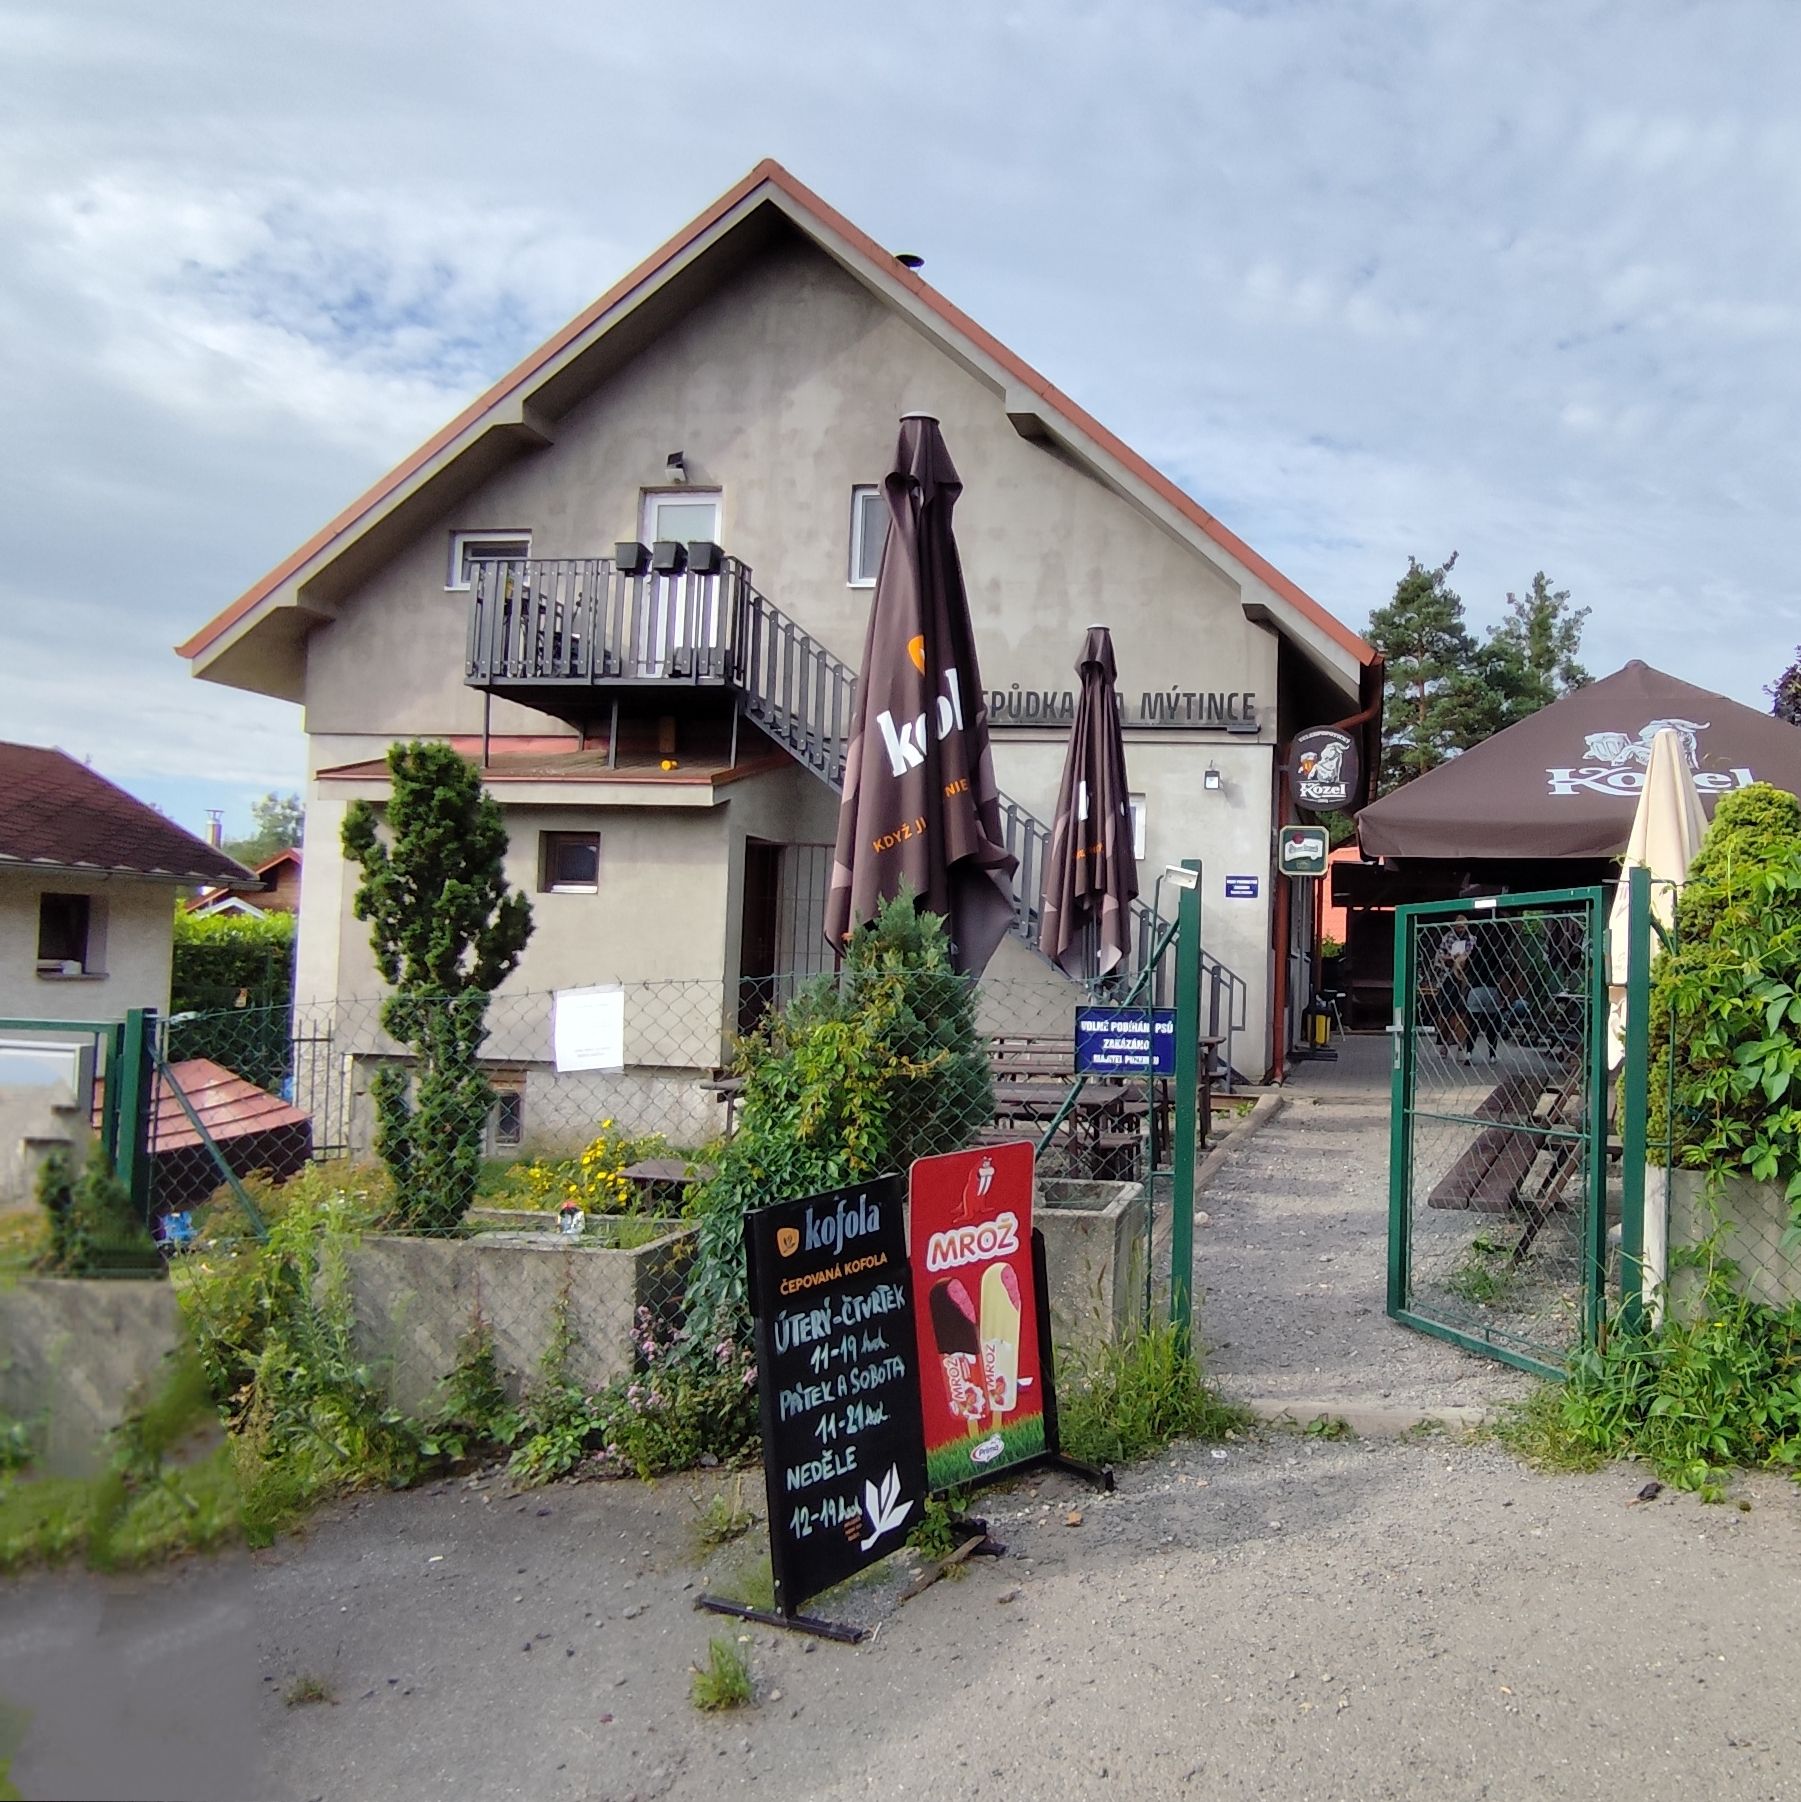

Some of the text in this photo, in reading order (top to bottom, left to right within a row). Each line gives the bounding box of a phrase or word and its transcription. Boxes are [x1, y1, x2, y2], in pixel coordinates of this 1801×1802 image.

[981, 683, 1075, 720] PŮDKA
[1140, 685, 1256, 721] MÝTINCE
[1300, 782, 1347, 799] Kozel
[1545, 766, 1754, 796] Koel
[873, 822, 913, 853] KDYŽ
[1103, 1037, 1150, 1050] ZAKÁZÁNO
[1111, 1020, 1150, 1033] POBÍHÁN
[805, 1193, 881, 1256] kofola
[930, 1216, 1015, 1267] MROŽ
[780, 1251, 889, 1296] ČEPOVANÁ KOFOLA
[779, 1354, 906, 1422] PÁTEK A SOBOTA
[786, 1444, 858, 1492] NEDĚLE
